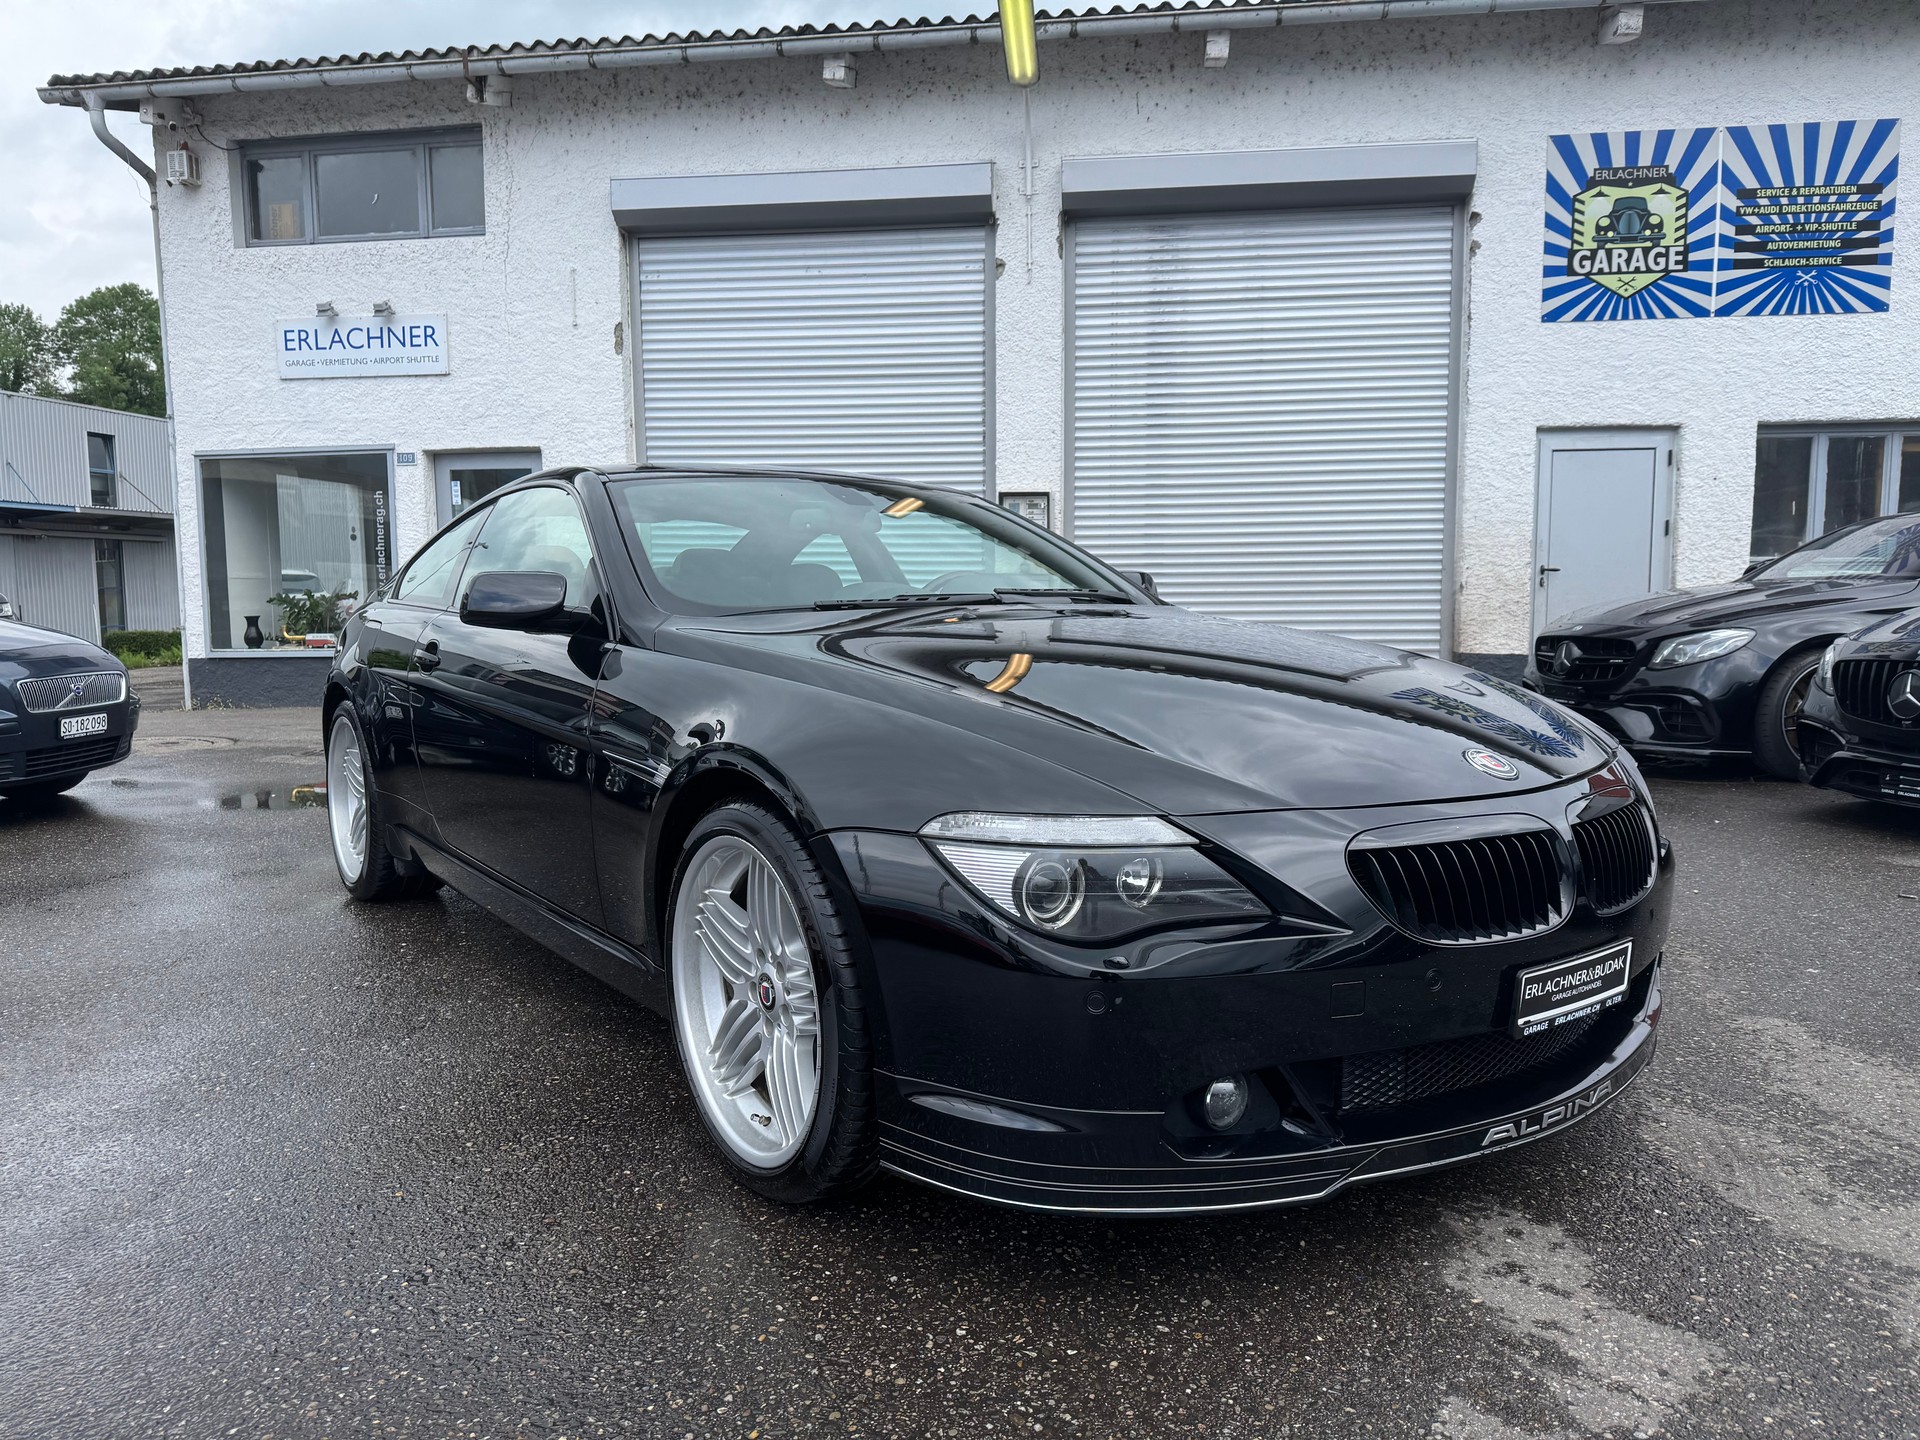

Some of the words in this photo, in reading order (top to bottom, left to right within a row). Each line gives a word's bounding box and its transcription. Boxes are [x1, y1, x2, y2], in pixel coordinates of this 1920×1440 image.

[1595, 166, 1668, 181] ERLACHNER
[1756, 188, 1790, 197] SERVICE
[1791, 187, 1798, 195] &
[1800, 185, 1857, 195] REPARATUREN
[1782, 201, 1879, 213] DIREKTIONSFAHRZEUGE
[1805, 222, 1858, 231] VIP-SHUTTLE
[1766, 239, 1841, 250] AUTOVERMIETUNG
[1572, 246, 1685, 275] GARAGE
[1763, 256, 1843, 267] SCHLAUCH-SERVICE
[283, 325, 440, 352] ERLACHNER
[285, 359, 316, 368] GARAGE
[319, 357, 369, 366] VERMIETUNG
[373, 356, 405, 364] AIRPORT
[406, 355, 440, 364] SHUTTLE
[1551, 989, 1572, 1001] GARAGE
[1523, 1021, 1549, 1035] GARAGE
[1605, 994, 1623, 1007] OLTEN
[1481, 1079, 1613, 1147] ALPINA
